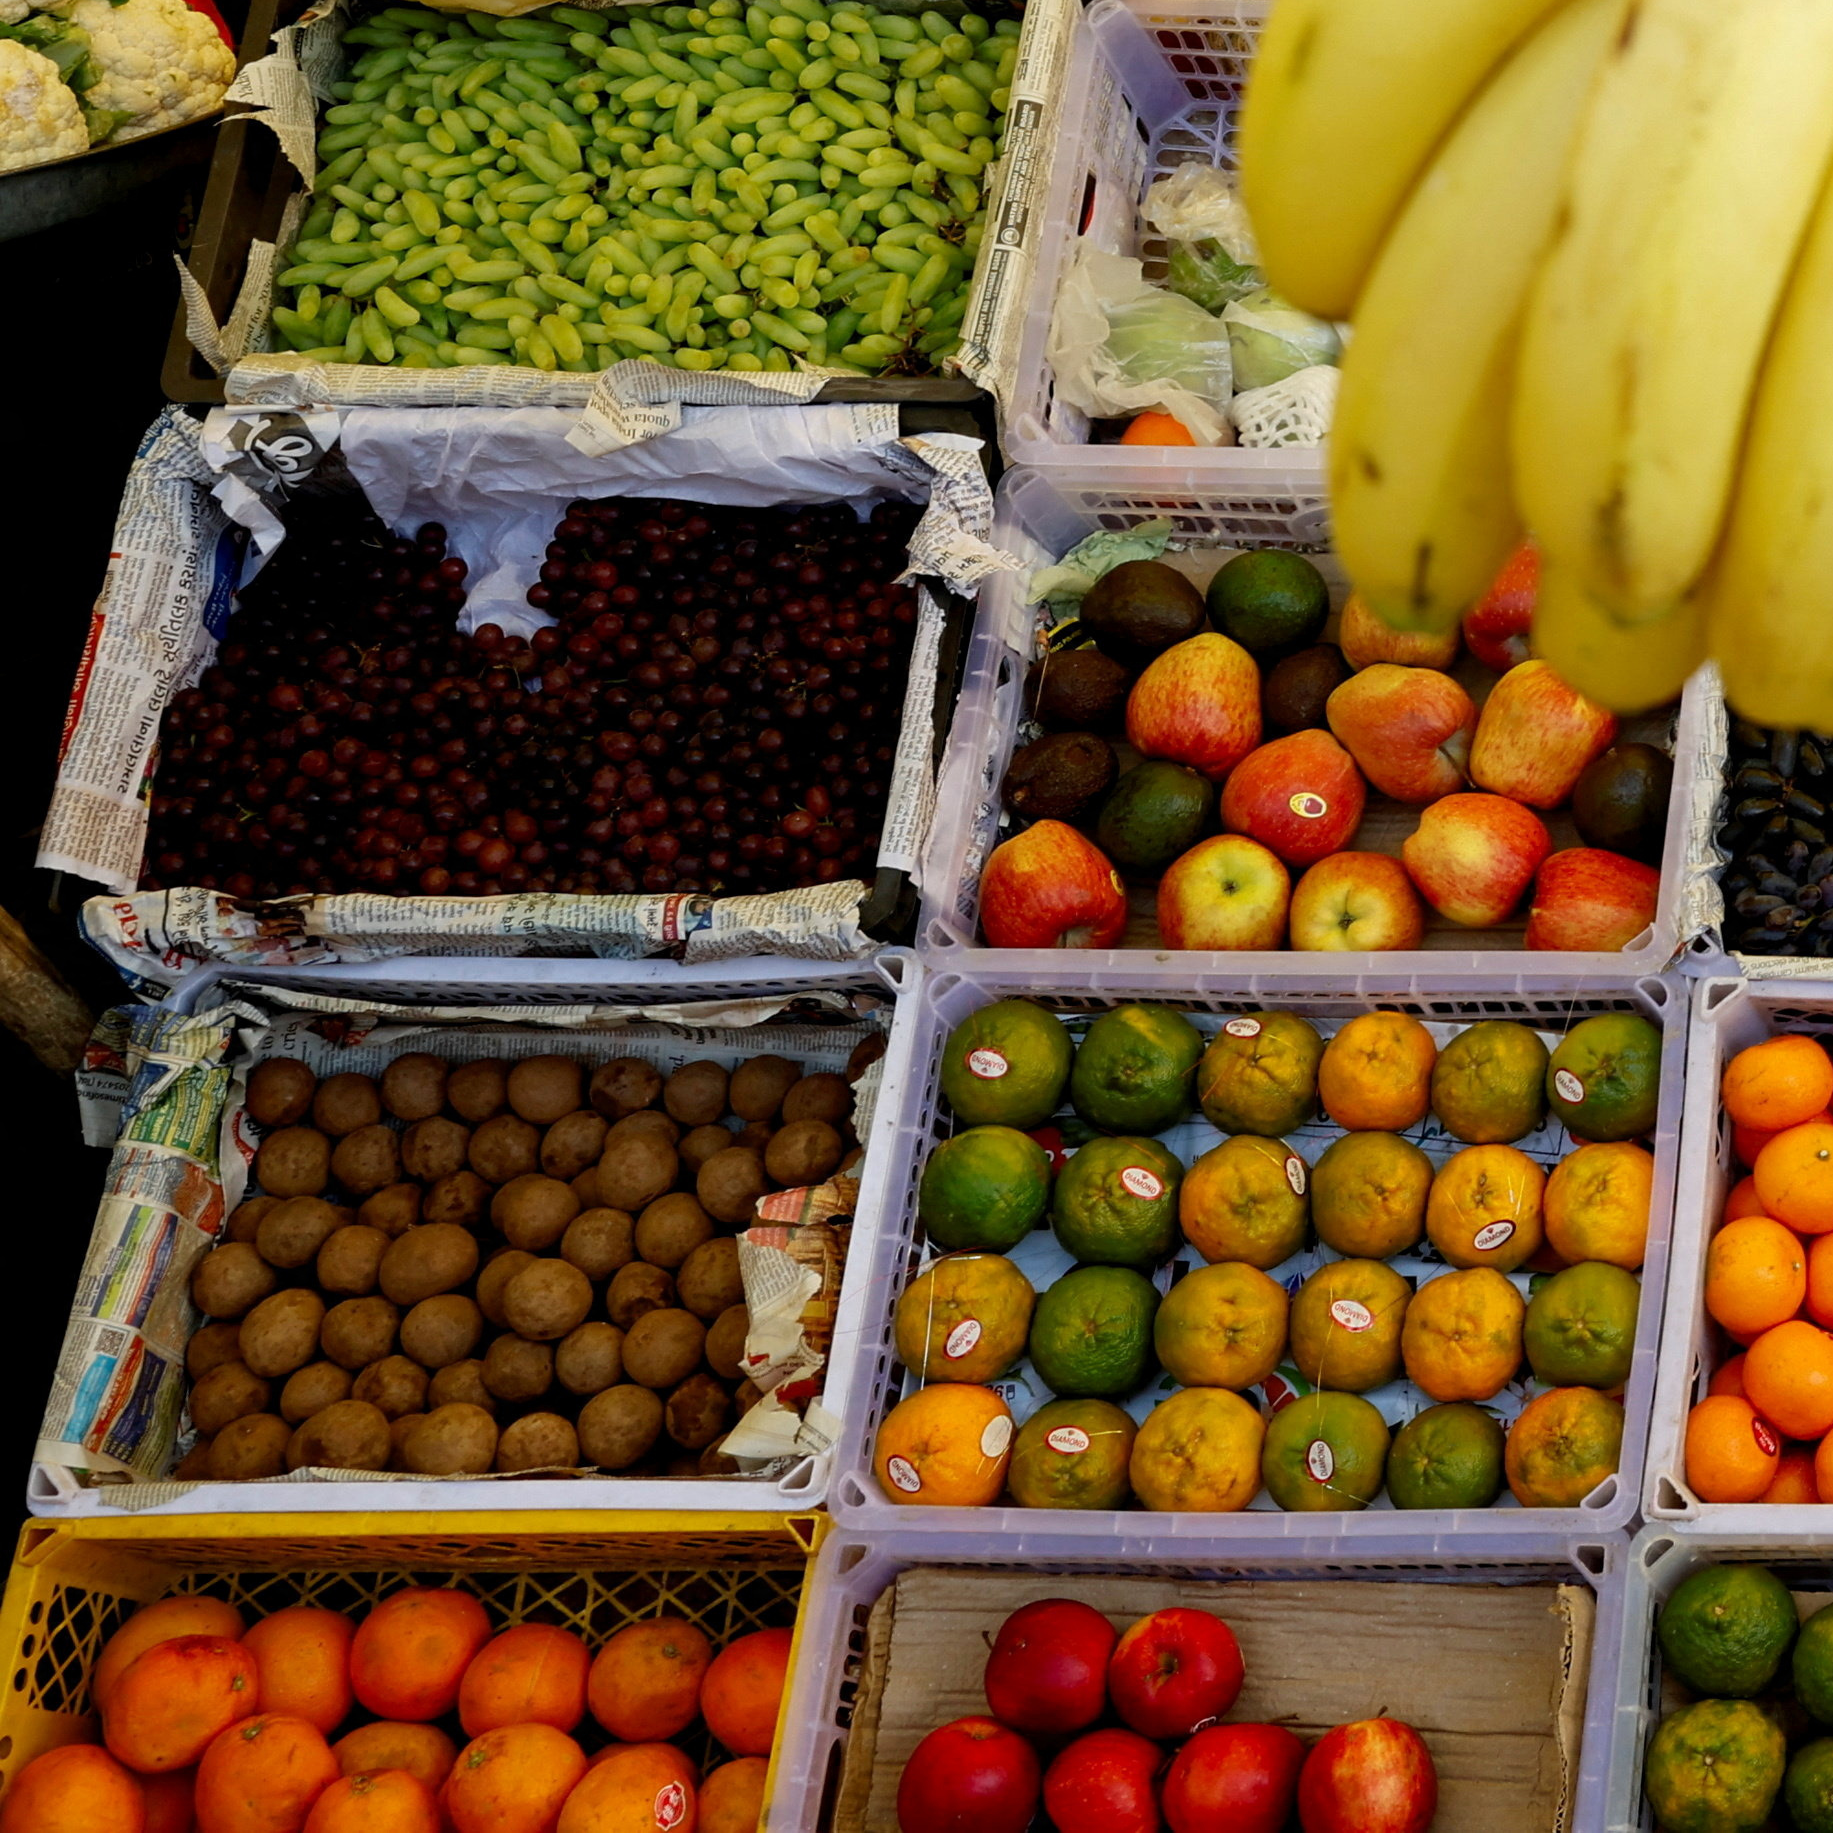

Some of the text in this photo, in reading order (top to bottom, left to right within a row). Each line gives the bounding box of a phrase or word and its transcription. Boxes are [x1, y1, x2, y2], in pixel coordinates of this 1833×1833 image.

[1007, 201, 1019, 226] WATER
[1013, 175, 1025, 201] SUPPLY
[249, 304, 264, 324] for
[634, 413, 669, 427] quota
[114, 712, 155, 796] રામલલાના
[261, 1034, 274, 1051] to
[972, 1054, 1005, 1071] DIAMOND
[1556, 1075, 1581, 1100] DIAMOND
[1125, 1172, 1157, 1195] DIAMOND
[1477, 1226, 1511, 1247] DIAMOND
[1334, 1304, 1368, 1322] DIAMOND
[949, 1321, 976, 1353] DIAMOND
[1051, 1434, 1085, 1449] DIAMOND
[1317, 1443, 1328, 1476] DIAMOND
[891, 1460, 919, 1488] DIAMOND
